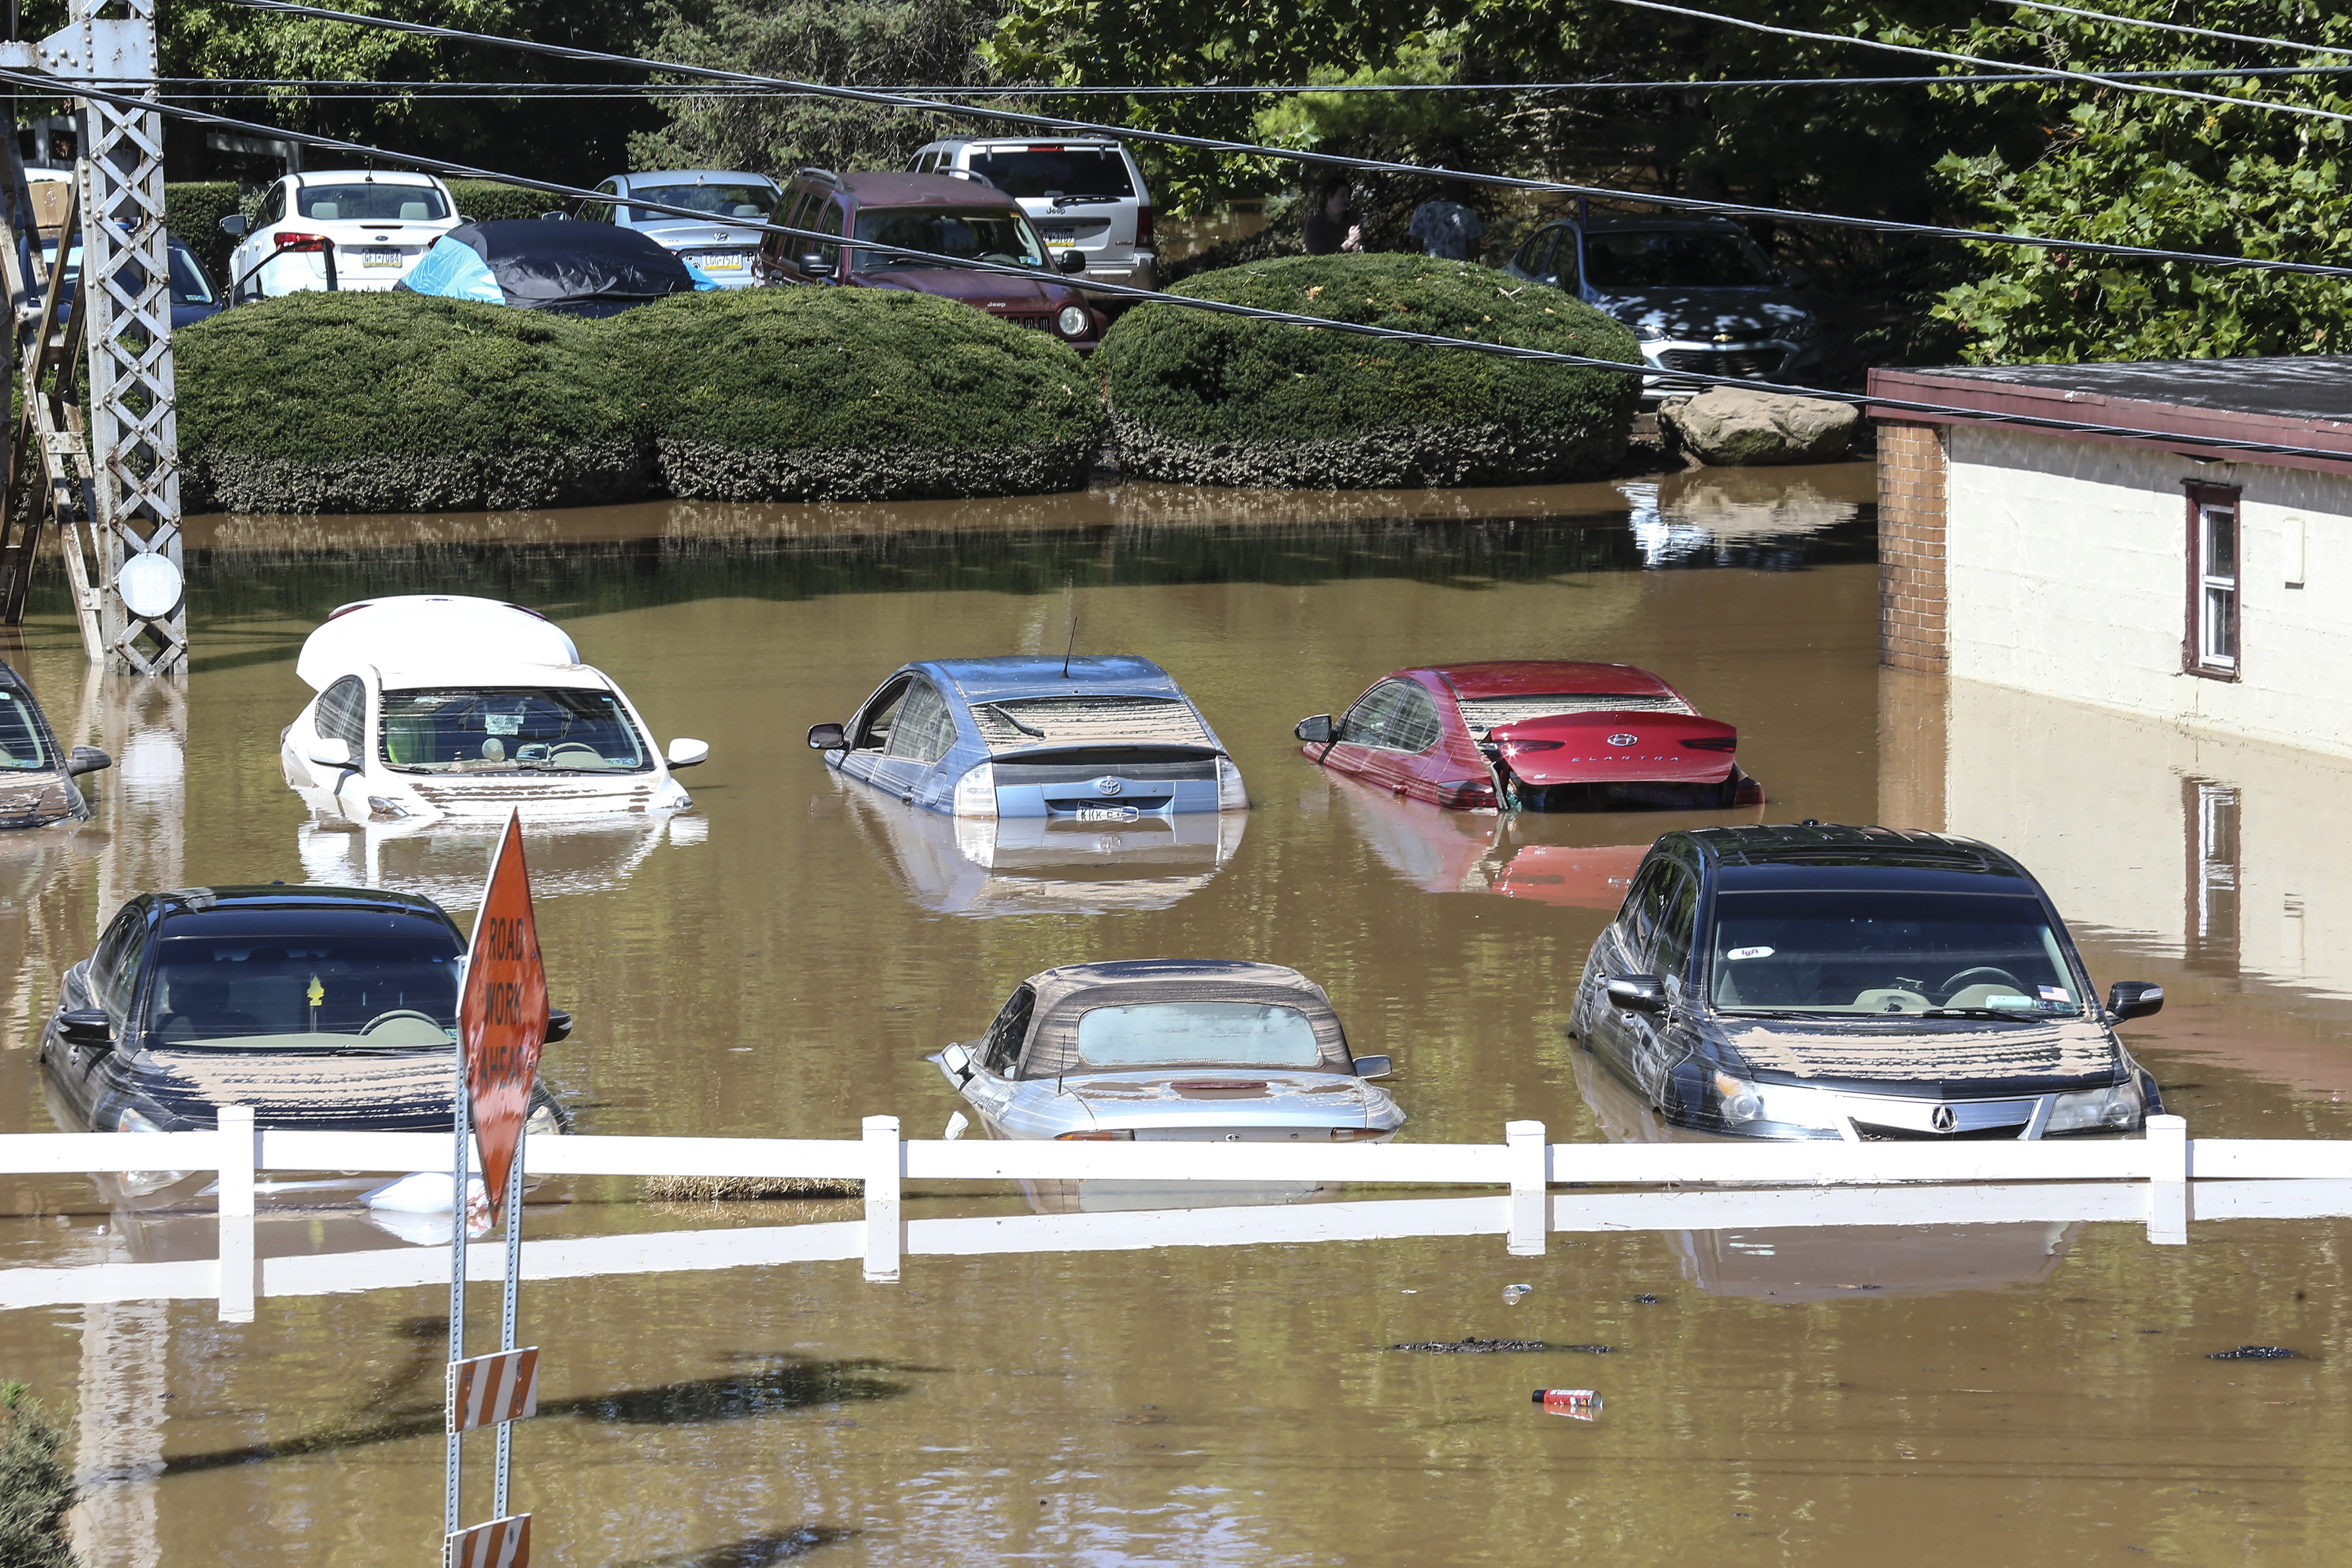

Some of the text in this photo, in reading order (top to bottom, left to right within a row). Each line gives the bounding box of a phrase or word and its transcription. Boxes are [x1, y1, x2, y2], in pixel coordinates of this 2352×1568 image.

[489, 917, 523, 961] ROAD
[1741, 948, 1759, 957] lyft
[485, 981, 523, 1026] WORK
[480, 1046, 524, 1089] AHEAD
